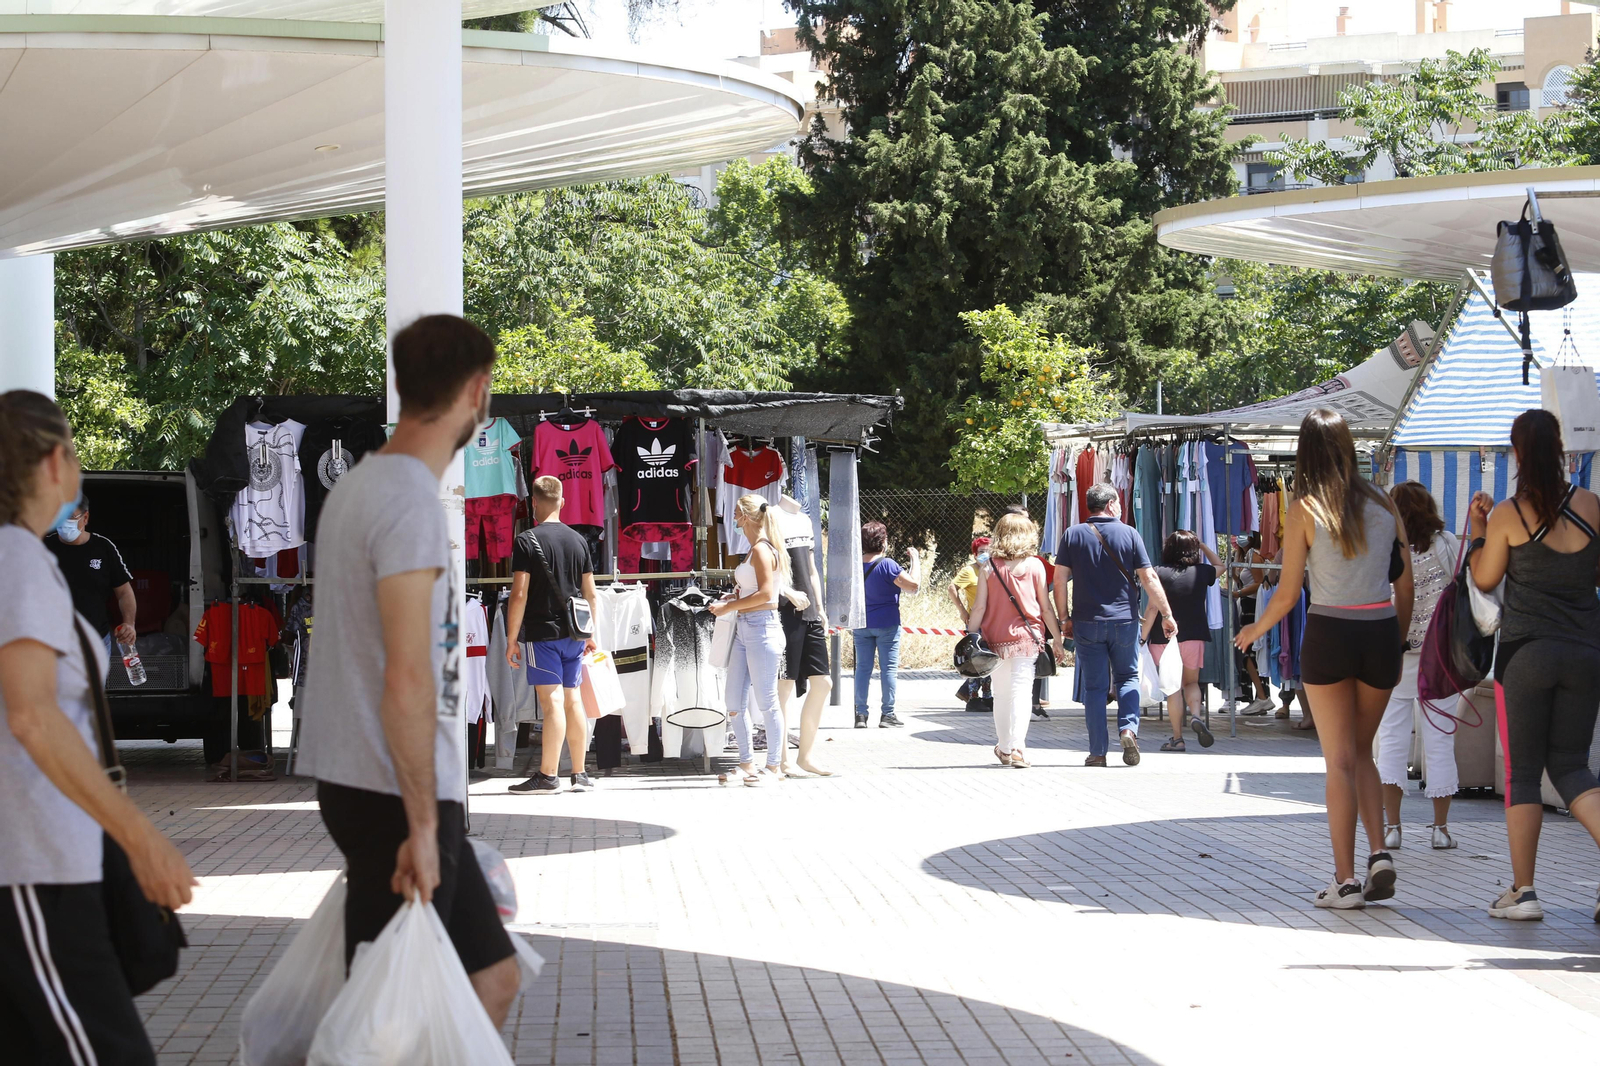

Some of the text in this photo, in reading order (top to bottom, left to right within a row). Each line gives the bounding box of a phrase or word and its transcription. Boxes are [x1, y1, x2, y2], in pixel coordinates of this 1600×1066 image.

[472, 456, 500, 467] adida
[558, 468, 593, 482] adidas
[637, 466, 679, 479] adidas
